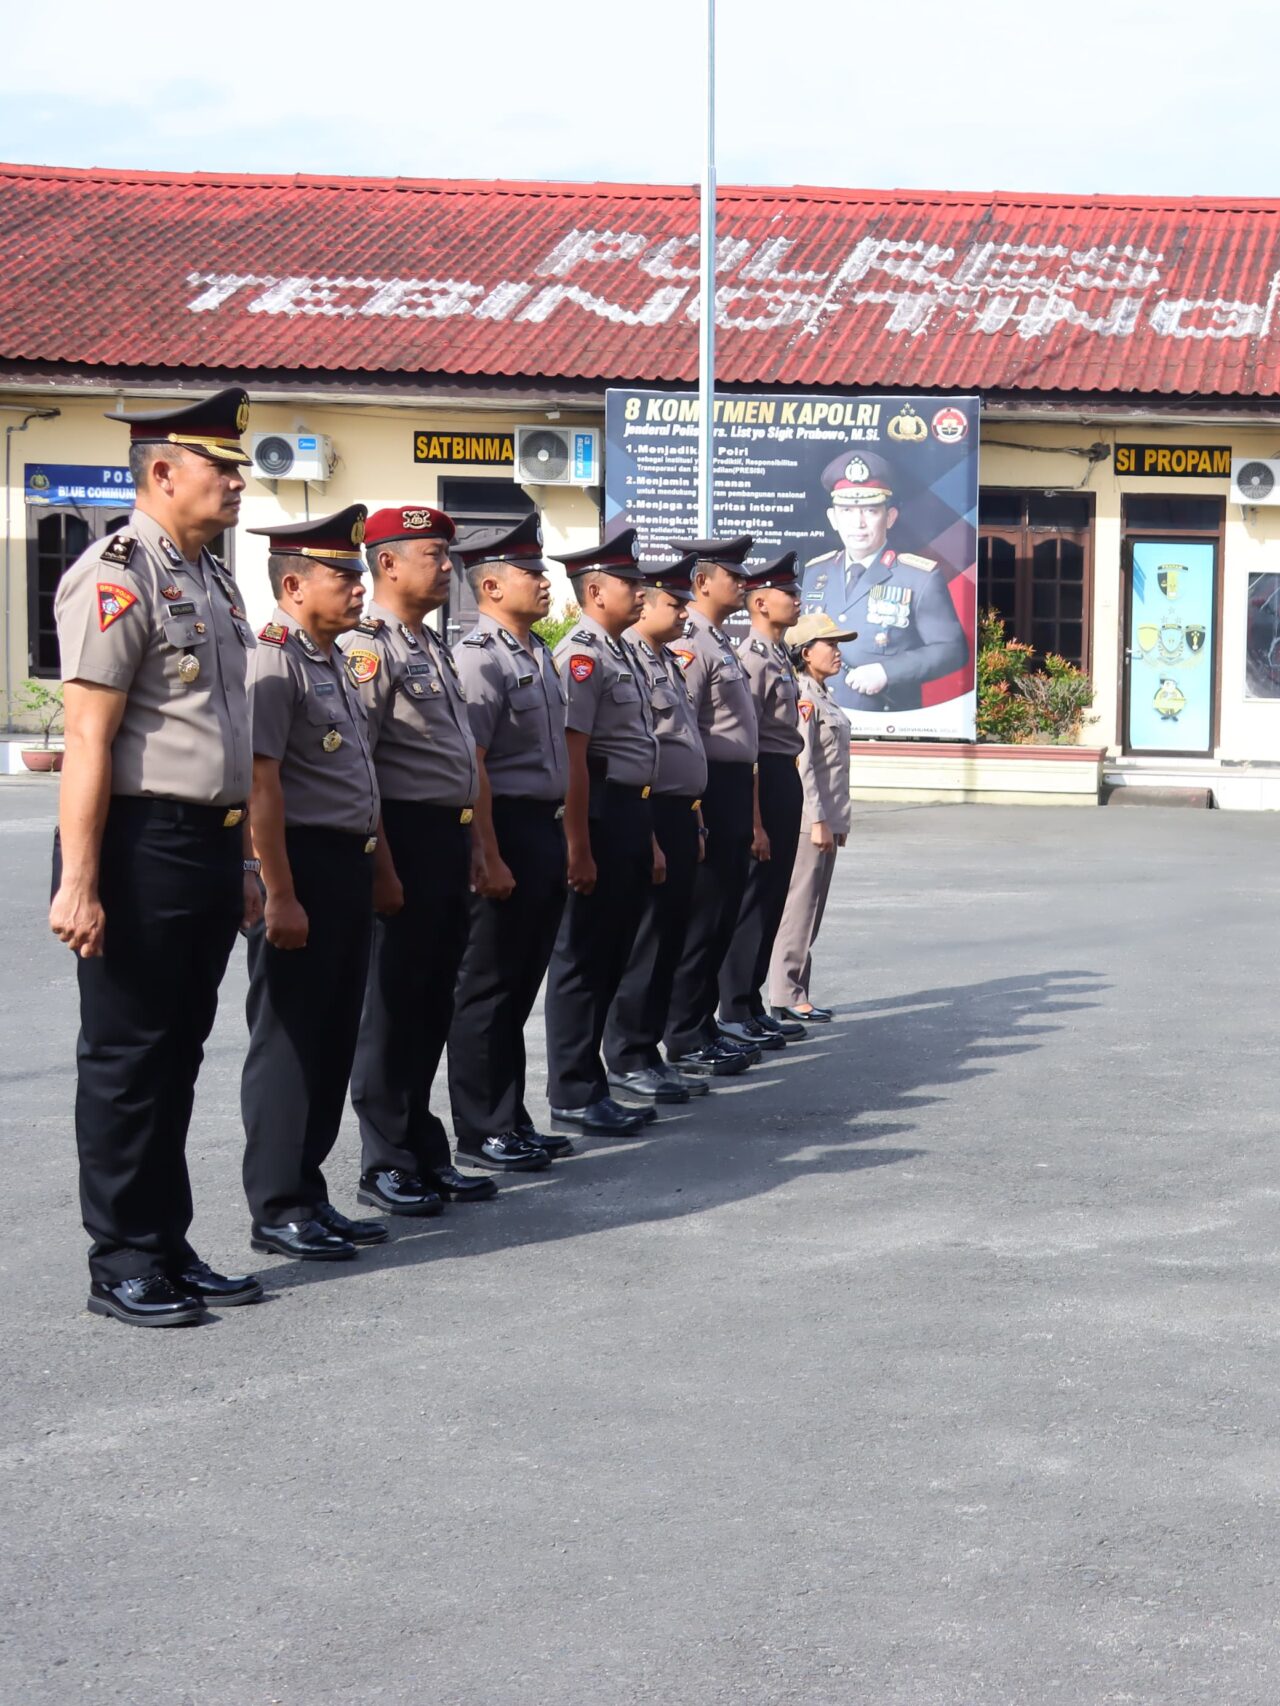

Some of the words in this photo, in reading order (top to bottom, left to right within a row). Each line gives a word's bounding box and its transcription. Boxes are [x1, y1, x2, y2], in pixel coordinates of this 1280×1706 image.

[535, 229, 1165, 289] POLRES
[624, 398, 641, 421] 8
[645, 399, 776, 424] KOMTMEN
[780, 402, 881, 426] KAPOLRI
[672, 424, 700, 437] Polis
[730, 426, 766, 441] Listyo
[767, 427, 795, 442] Sigit
[796, 427, 849, 443] Prabowo,
[416, 436, 514, 461] SATBINMA
[718, 446, 749, 456] Polri
[1116, 447, 1136, 472] SI
[1144, 449, 1231, 473] PROPAM
[58, 485, 86, 498] BLUE
[87, 486, 137, 500] COMMUNI
[686, 502, 747, 512] soaritas
